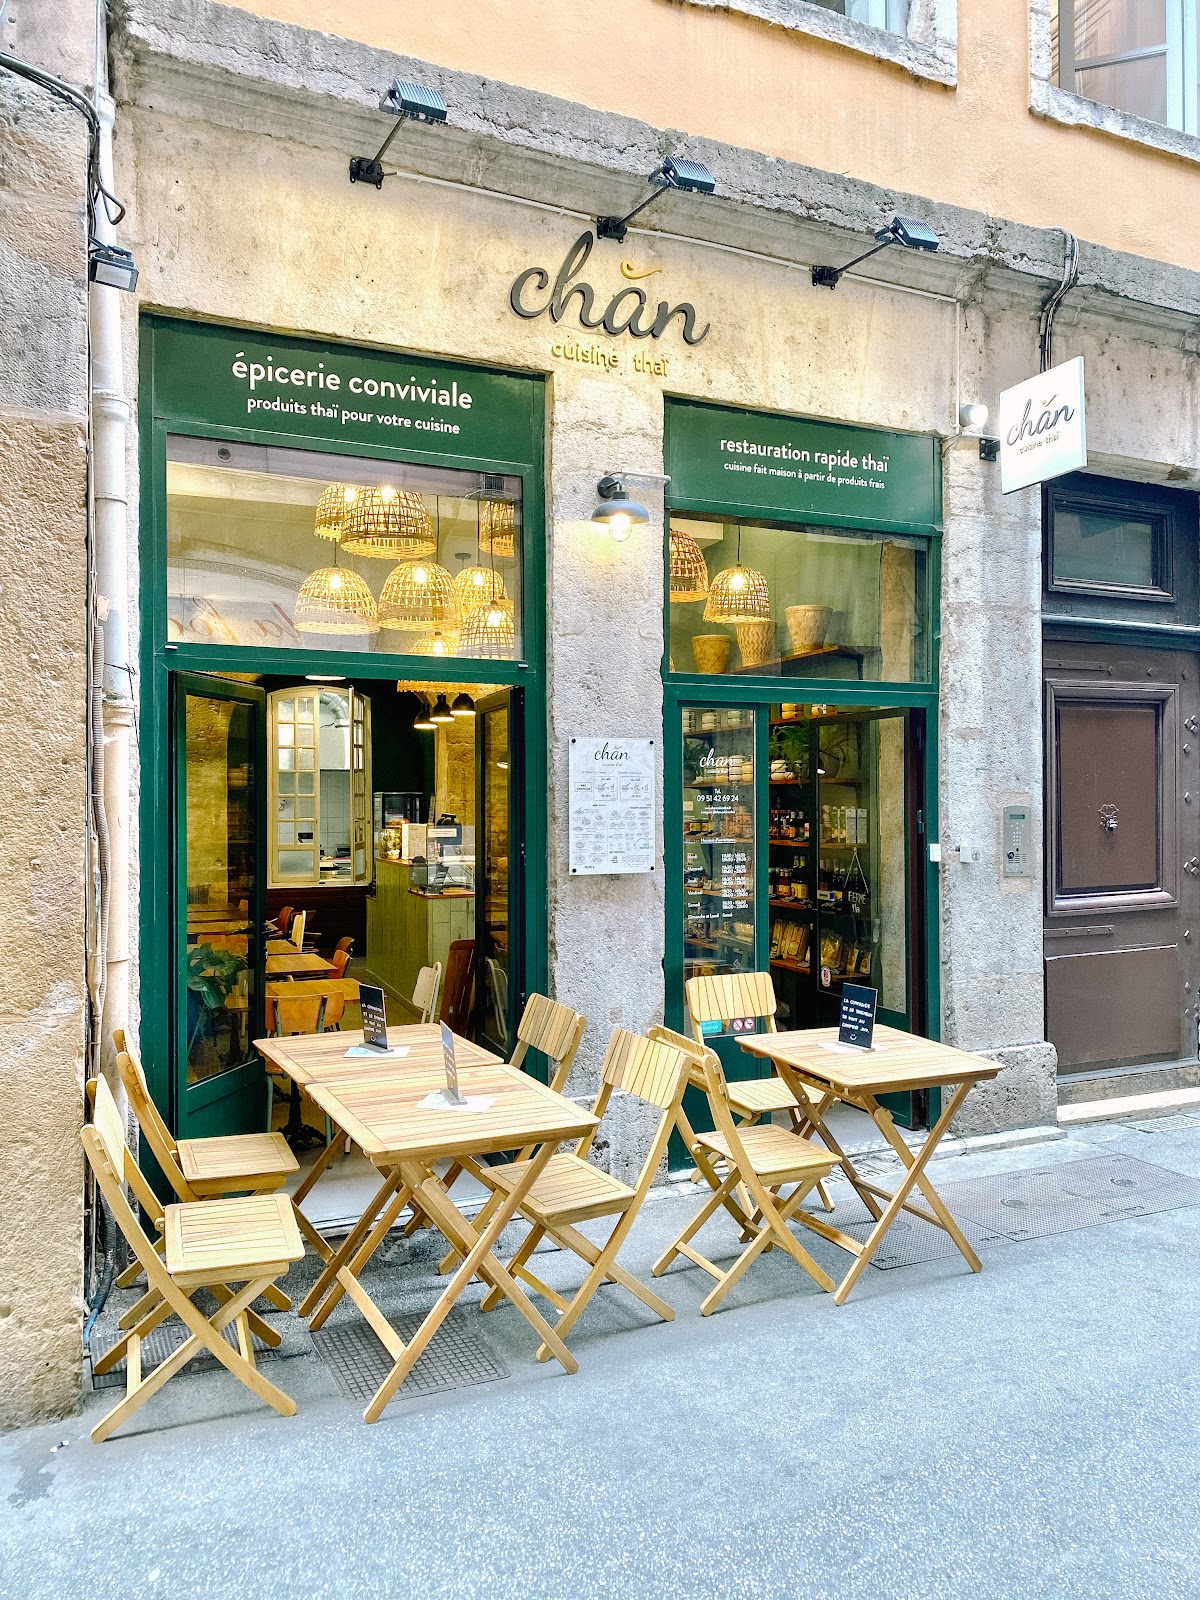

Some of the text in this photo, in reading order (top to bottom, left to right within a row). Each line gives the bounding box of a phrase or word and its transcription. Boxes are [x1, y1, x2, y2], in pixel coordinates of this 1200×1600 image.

[551, 342, 670, 378] cuisine thaï
[232, 351, 473, 410] épicerie conviviale
[247, 396, 461, 435] produits thaï pour votre cuisine
[720, 438, 890, 473] restauration rapide thaï
[724, 460, 885, 490] cuisine fait maison à partir de produits frais
